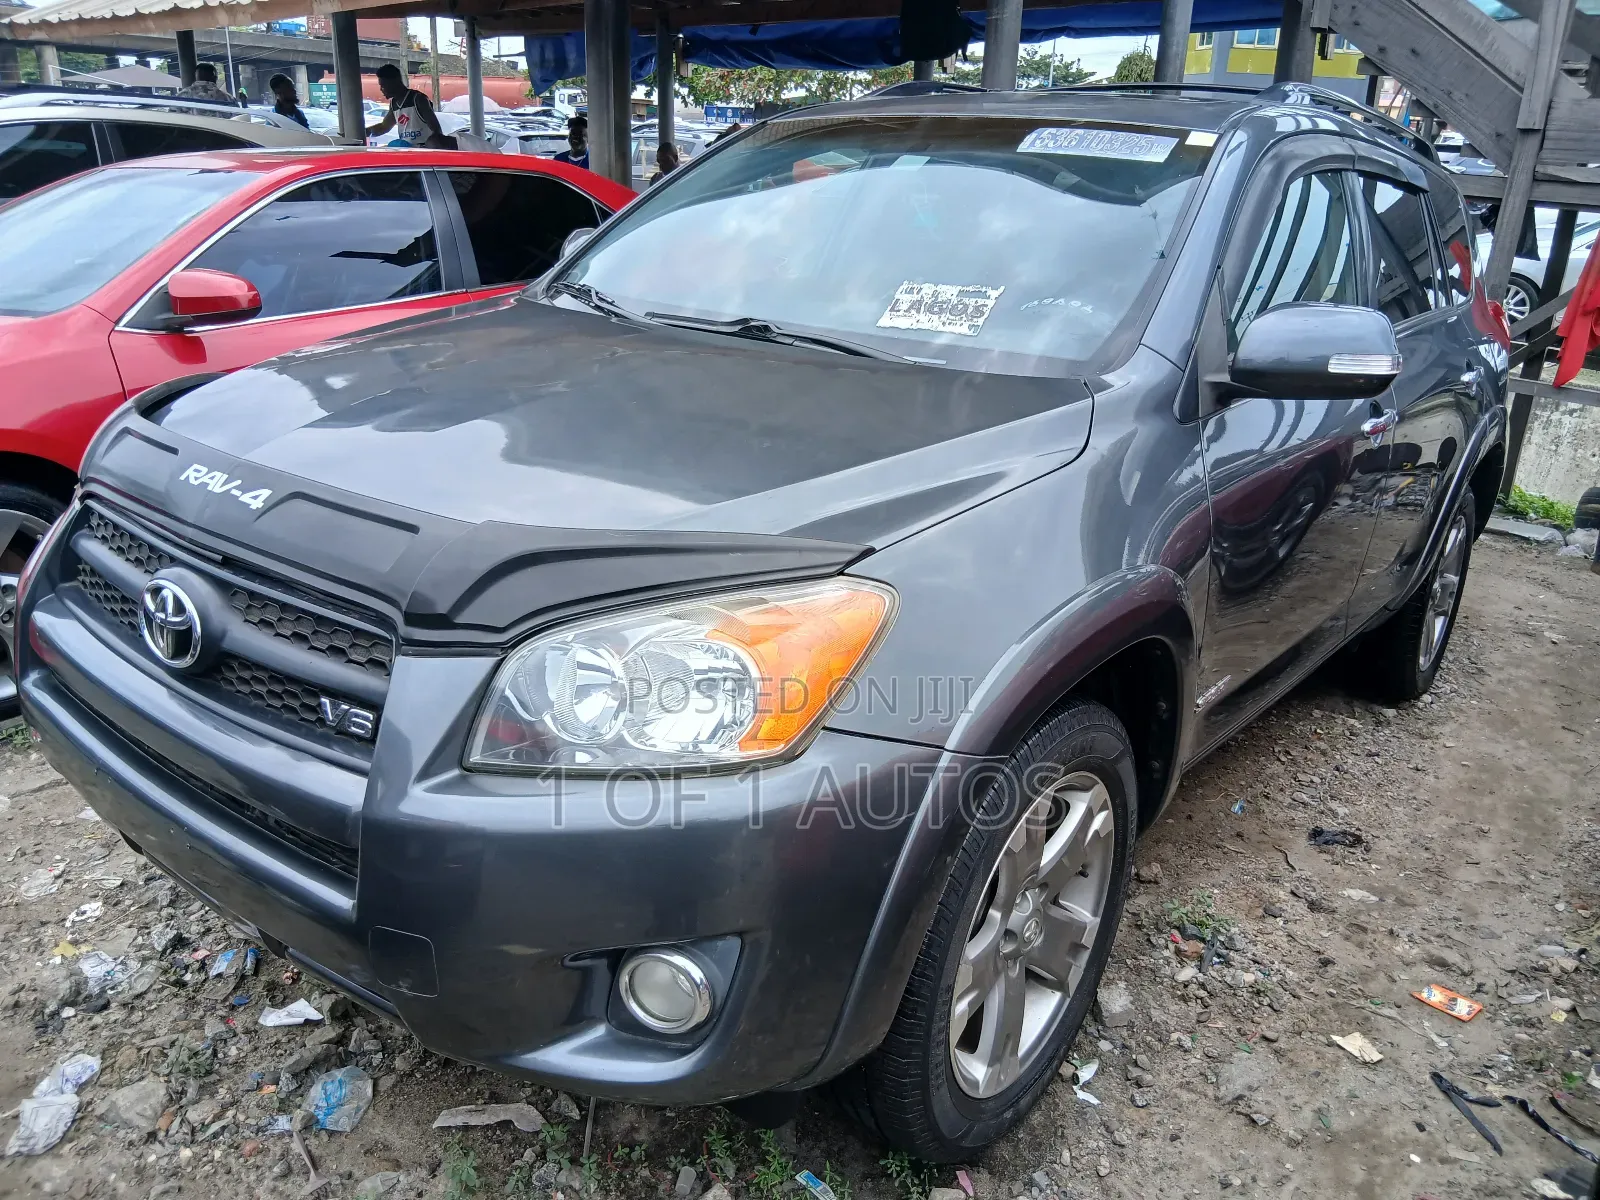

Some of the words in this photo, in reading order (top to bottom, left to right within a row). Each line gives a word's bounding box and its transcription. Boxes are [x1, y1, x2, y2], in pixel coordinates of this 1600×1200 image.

[888, 298, 989, 319] LAGOS
[179, 463, 273, 510] RAV-4
[319, 696, 375, 738] V6
